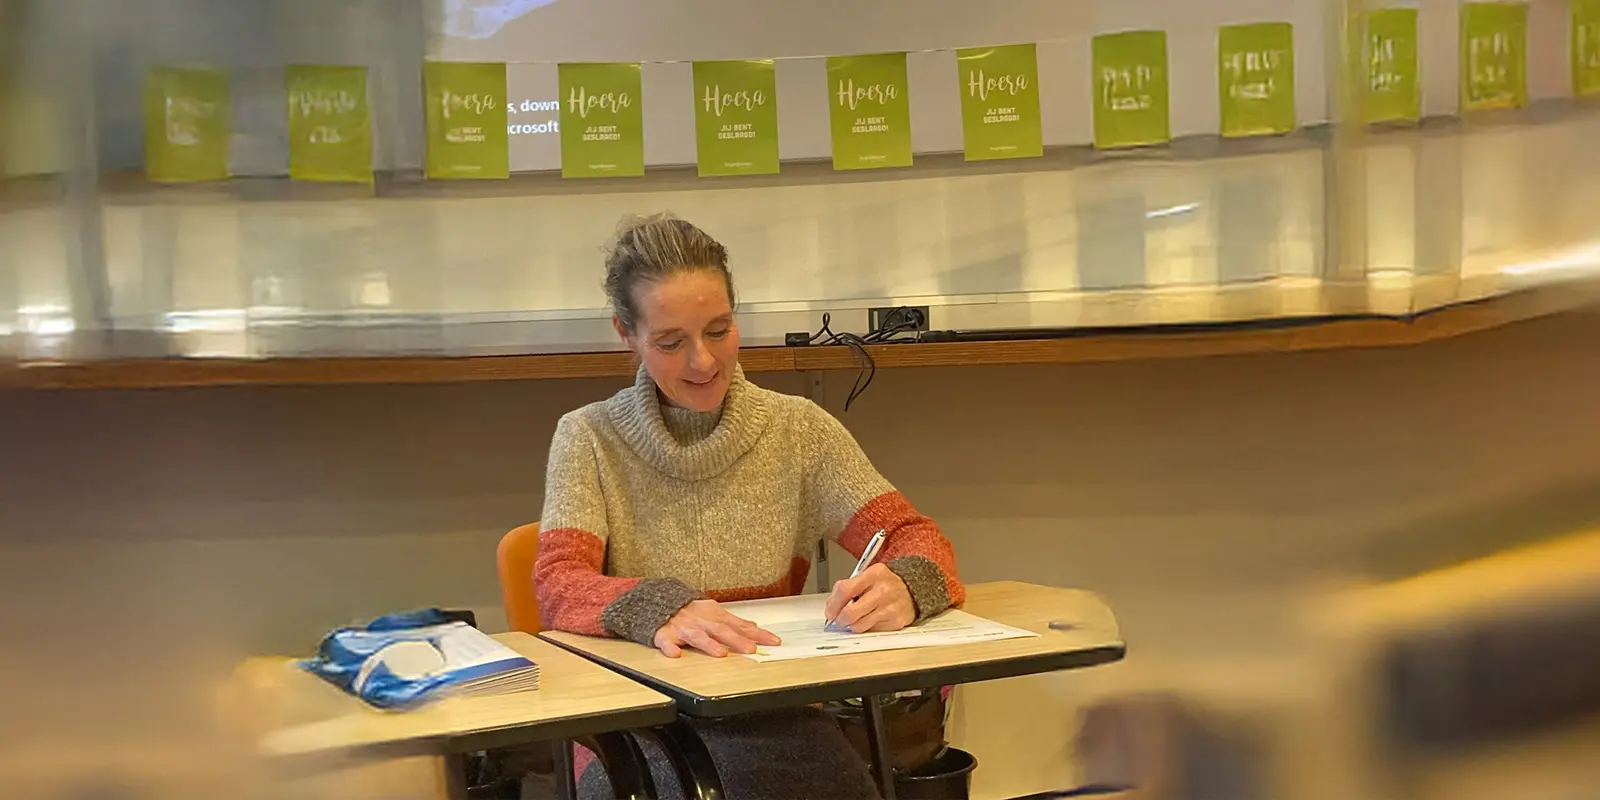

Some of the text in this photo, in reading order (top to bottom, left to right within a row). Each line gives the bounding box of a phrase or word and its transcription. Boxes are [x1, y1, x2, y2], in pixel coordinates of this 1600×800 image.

[703, 85, 767, 117] Hoera
[836, 79, 898, 111] Hoera
[967, 69, 1029, 101] Hoera
[442, 90, 497, 119] era
[567, 86, 632, 118] Hoera
